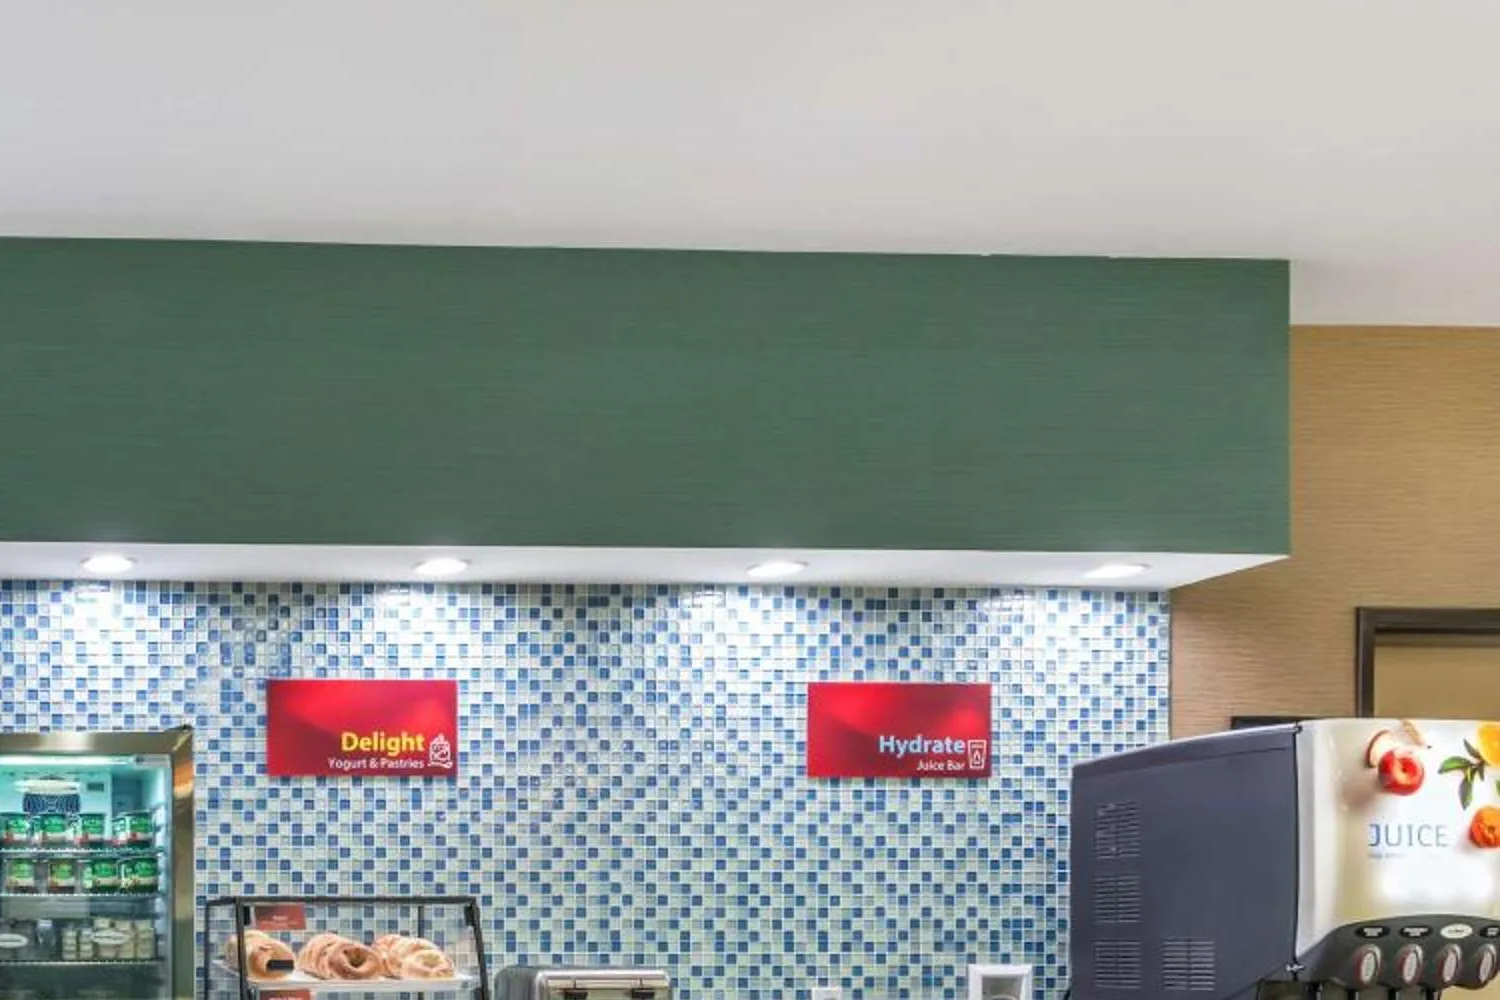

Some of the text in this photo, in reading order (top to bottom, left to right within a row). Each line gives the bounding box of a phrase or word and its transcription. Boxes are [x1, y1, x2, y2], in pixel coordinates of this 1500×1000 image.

[340, 730, 426, 757] Delight
[879, 733, 966, 759] Hydrate
[326, 757, 425, 772] Yogurt & Pastries
[916, 759, 965, 771] Juice Bar
[1367, 823, 1450, 848] JUICE
